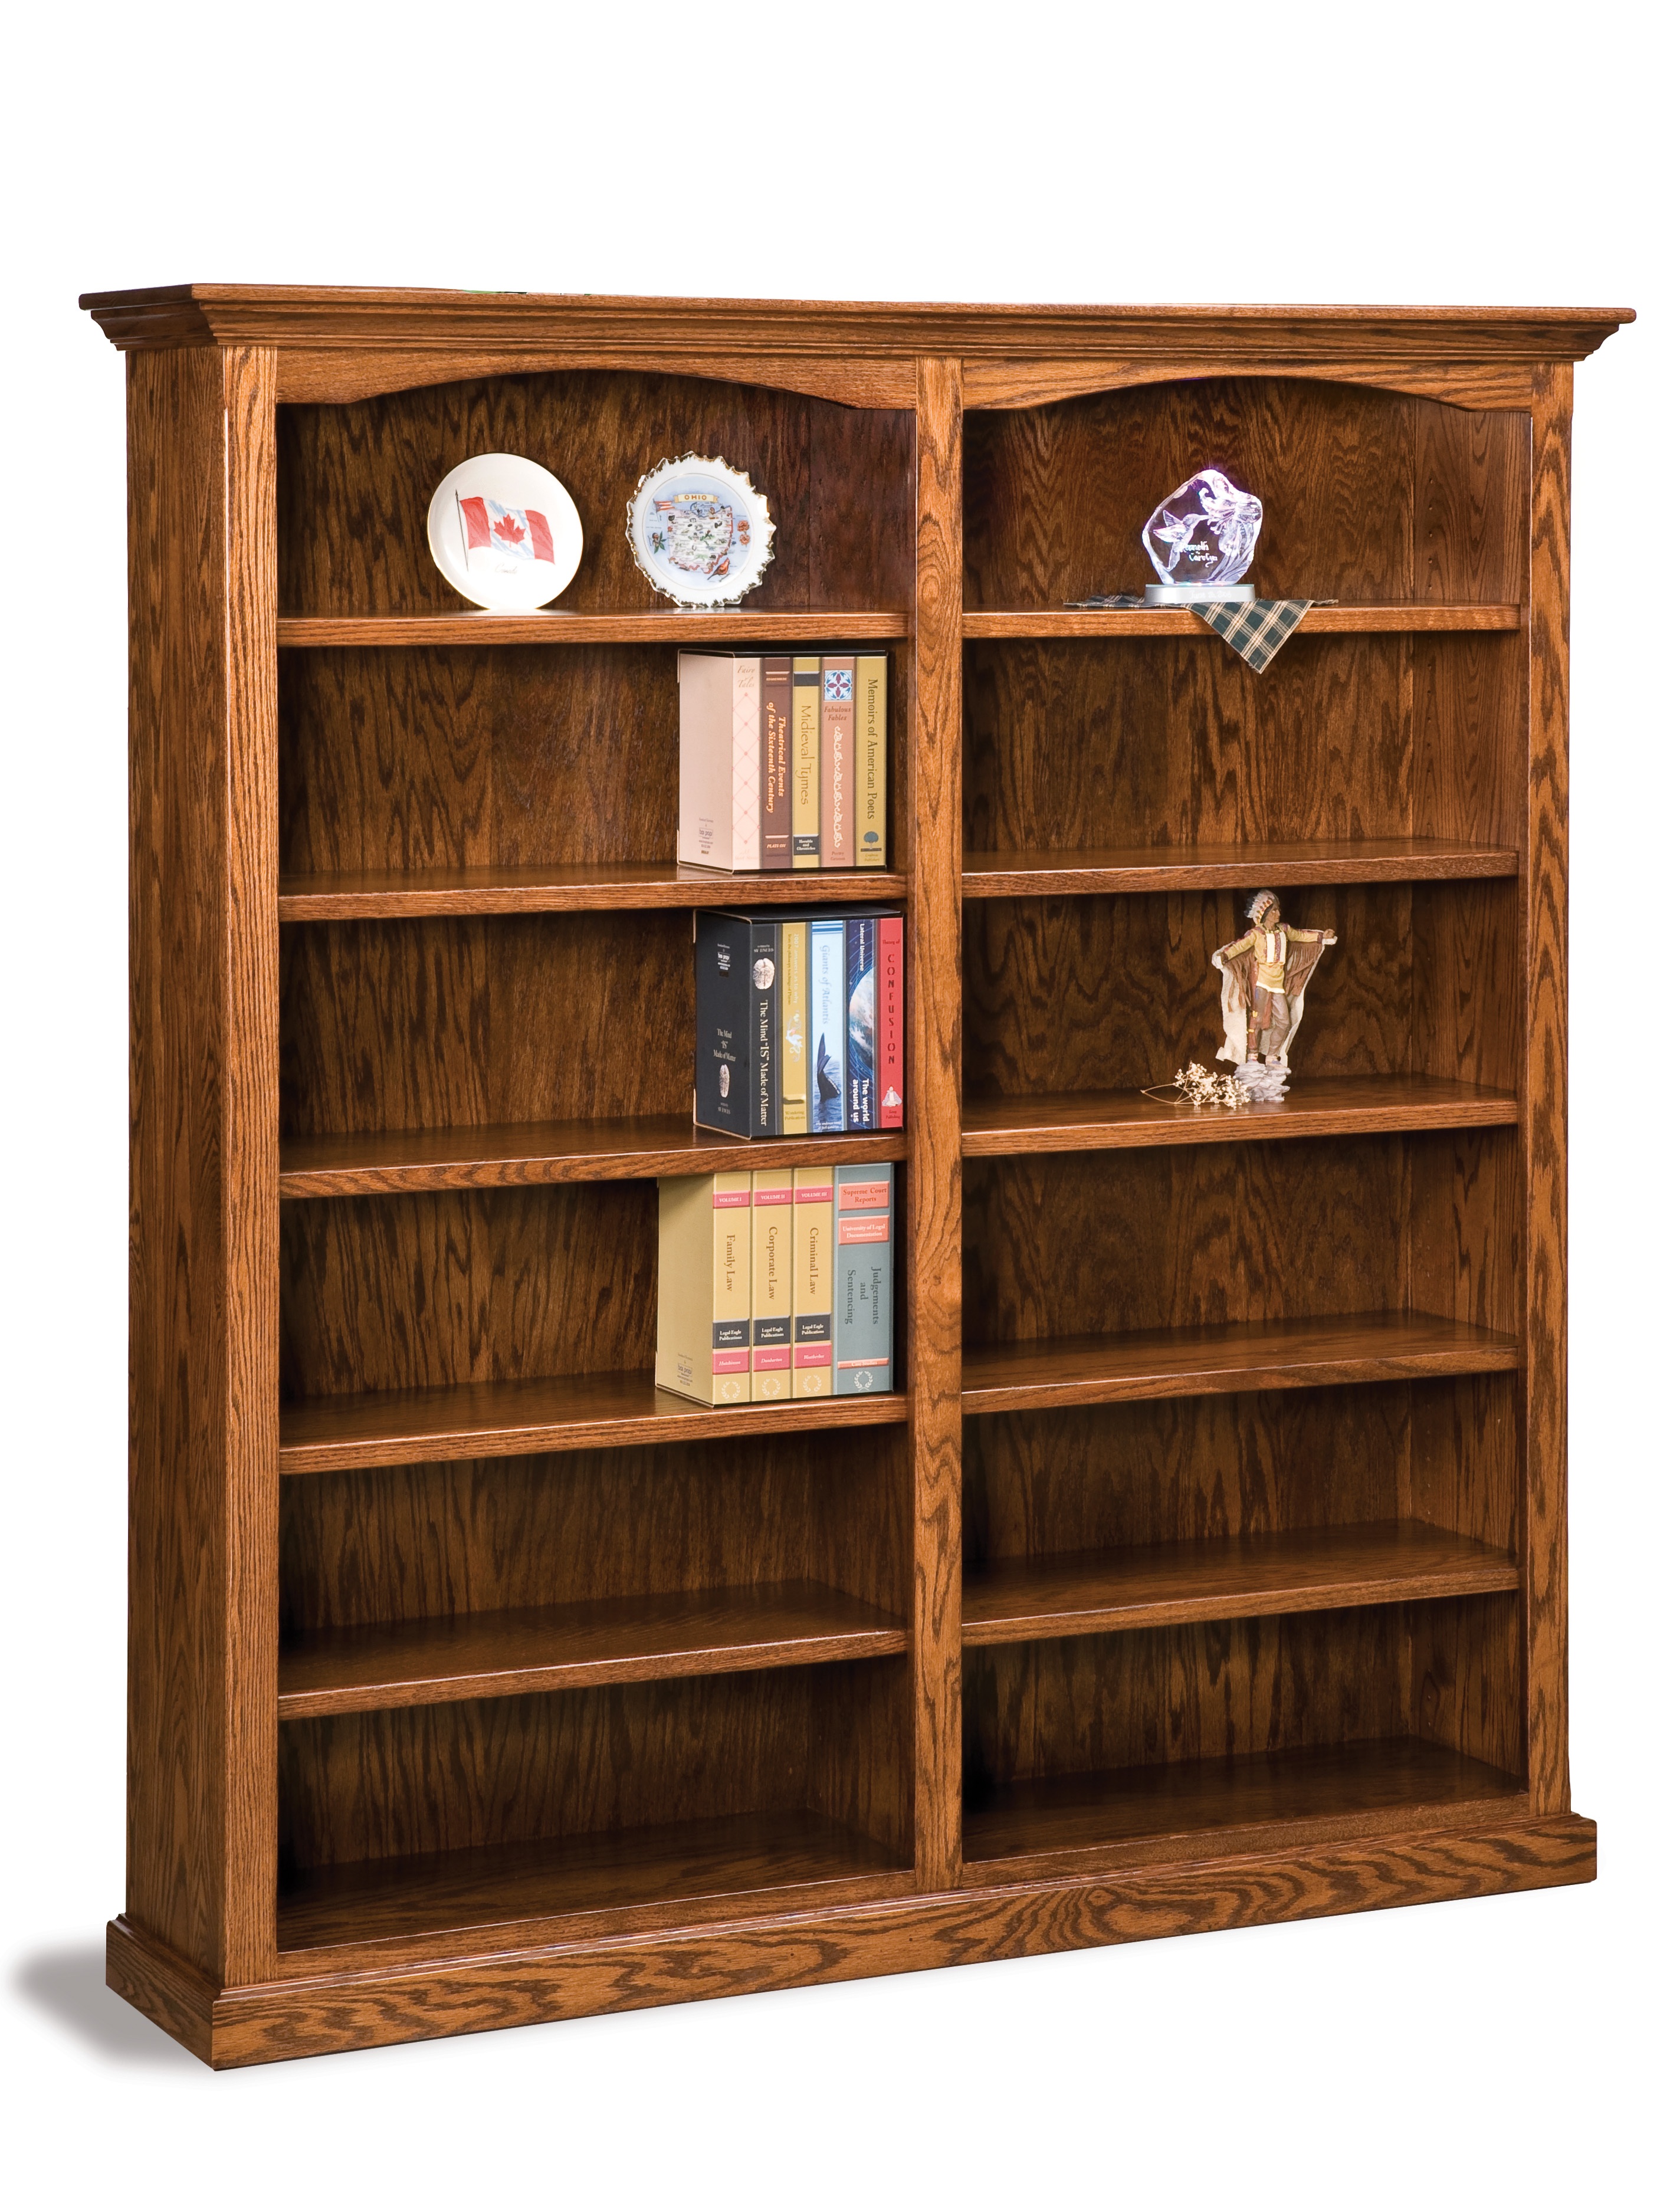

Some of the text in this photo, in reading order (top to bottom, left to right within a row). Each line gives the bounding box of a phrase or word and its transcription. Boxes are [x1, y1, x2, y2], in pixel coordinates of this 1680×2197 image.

[737, 665, 755, 674] Fairy
[737, 676, 755, 688] Tales
[766, 702, 776, 713] of
[795, 705, 815, 805] Midieval Tymes
[867, 679, 878, 820] Memoirs of American Poets
[766, 776, 776, 813] Century
[818, 945, 832, 1024] Giants of Atlantis
[760, 1000, 768, 1017] The
[887, 954, 896, 1064] CONFUSION
[724, 1030, 732, 1038] Mind
[760, 1019, 768, 1042] Mind
[714, 1049, 722, 1058] Made
[760, 1087, 769, 1096] of
[760, 1097, 769, 1127] Matter
[853, 1112, 859, 1123] us
[723, 1234, 736, 1292] Family Law
[766, 1226, 777, 1300] Corporate Law
[809, 1227, 819, 1295] Criminal Law
[845, 1269, 857, 1325] Sentencing
[860, 1282, 868, 1301] and
[870, 1266, 881, 1325] Judgements
